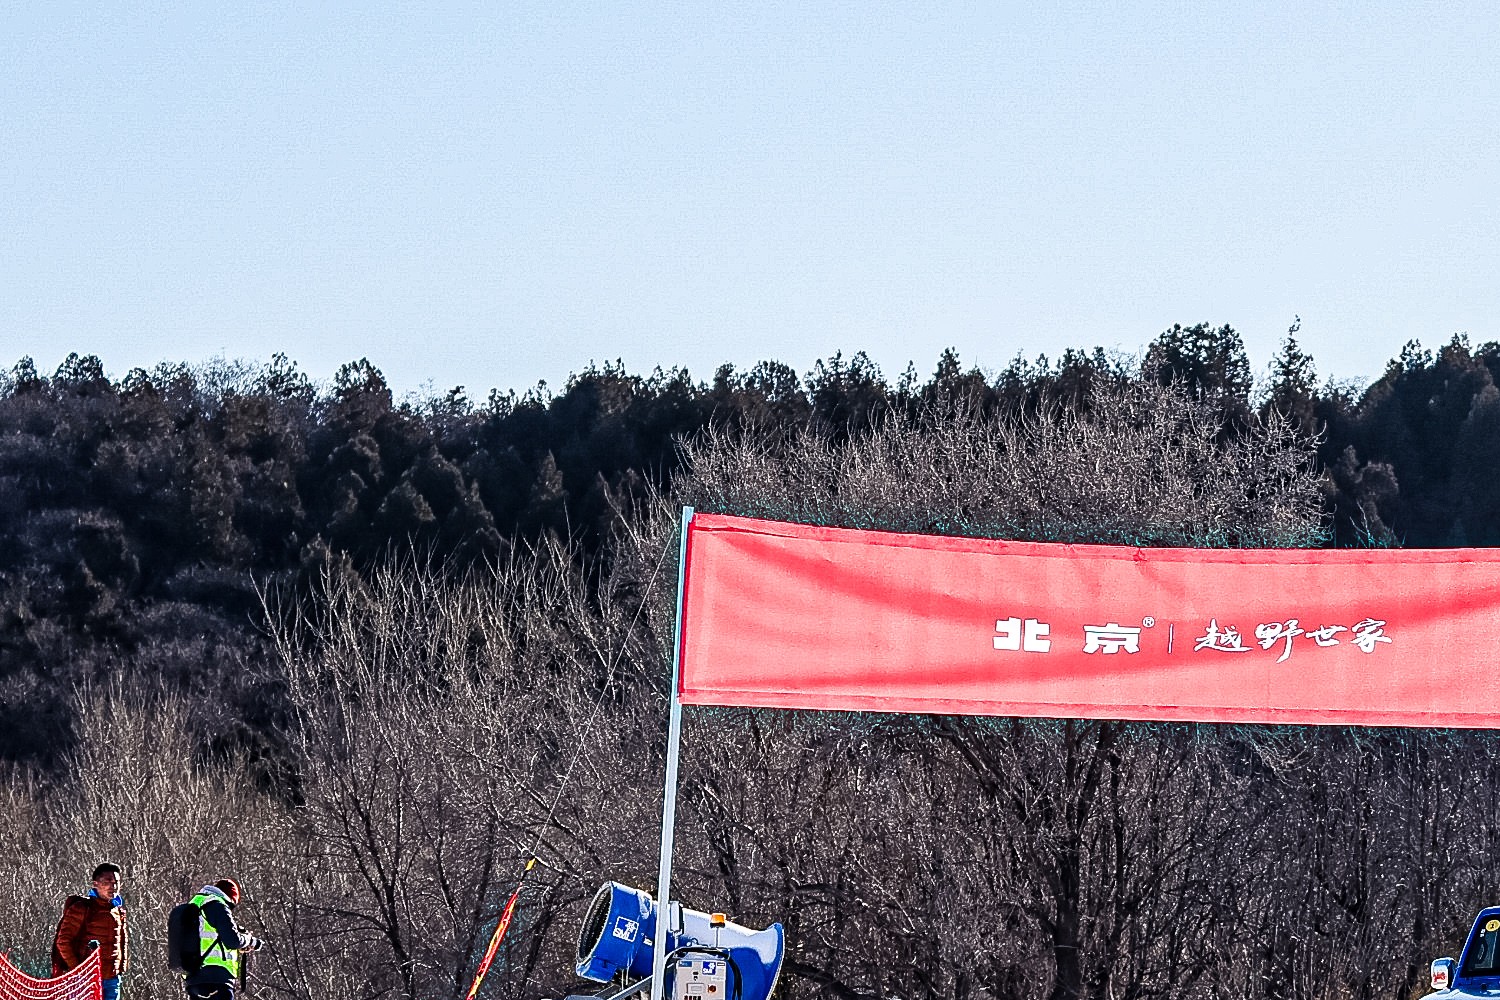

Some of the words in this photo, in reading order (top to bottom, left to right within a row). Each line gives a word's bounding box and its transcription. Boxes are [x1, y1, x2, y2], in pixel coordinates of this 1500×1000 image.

[992, 616, 1142, 654] 北京
[1194, 617, 1393, 664] 越野世家
